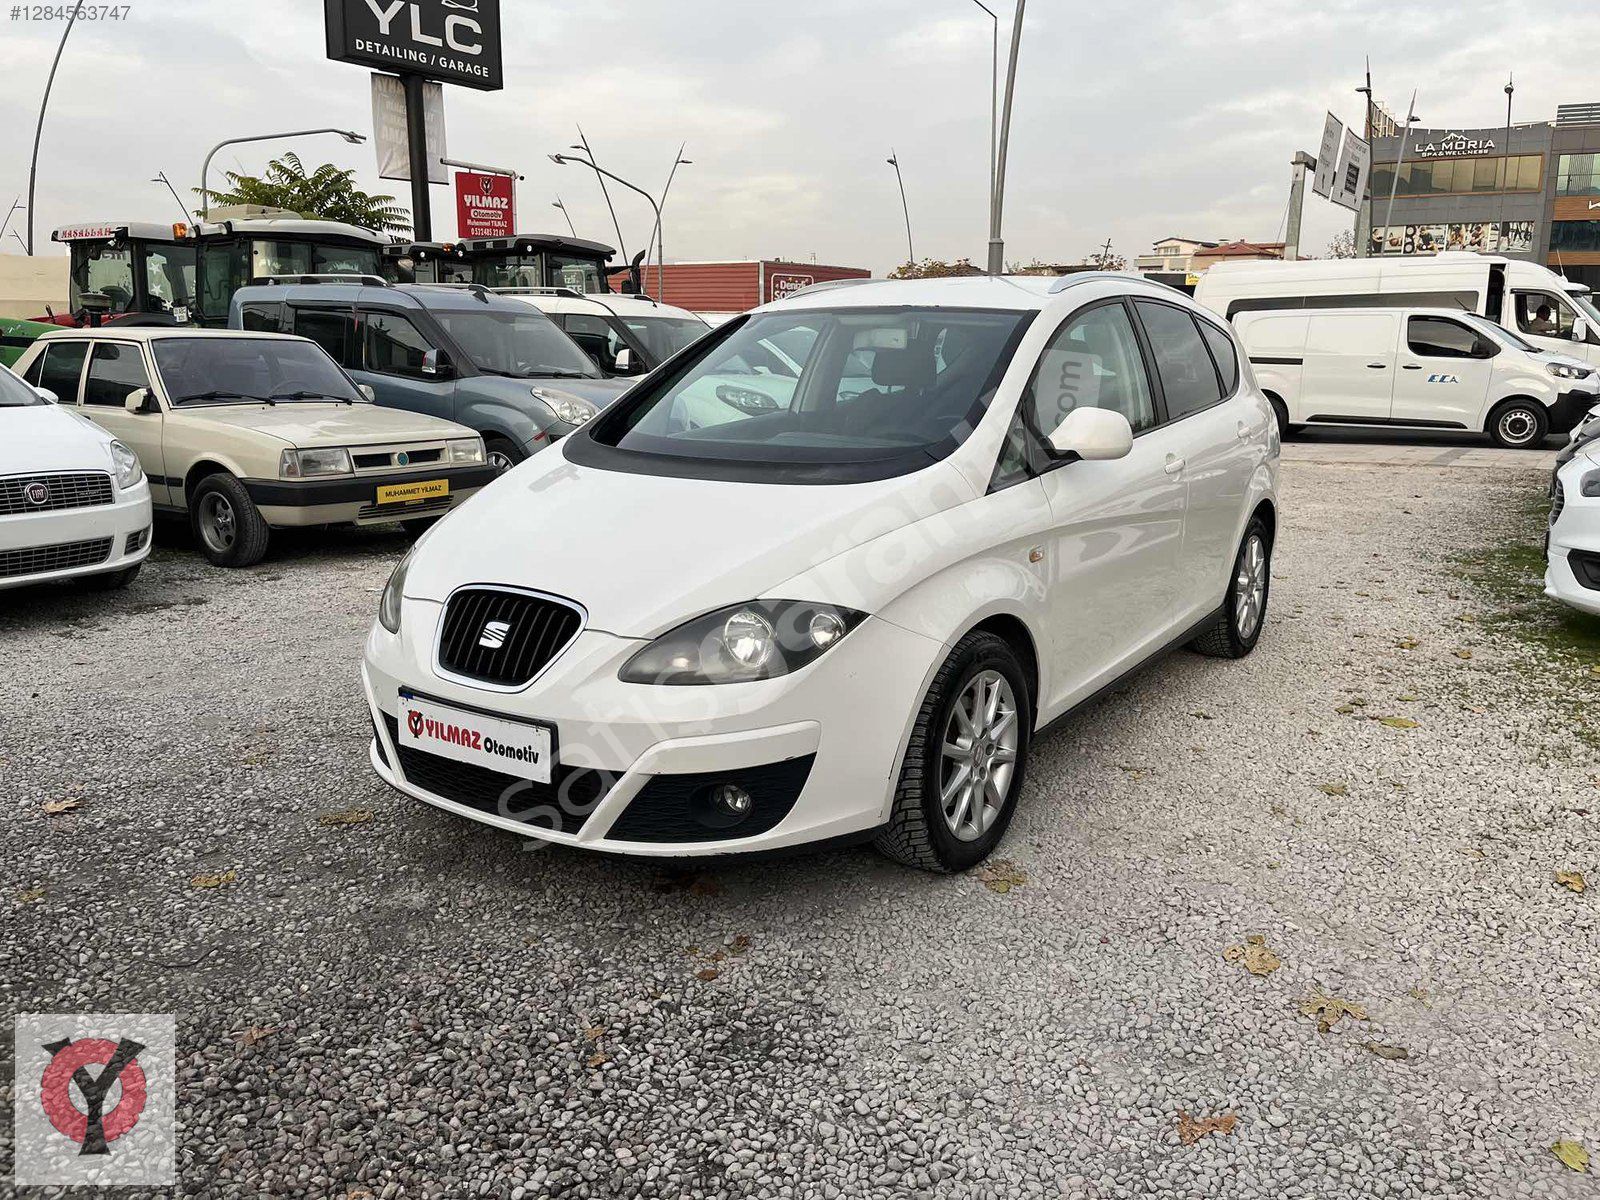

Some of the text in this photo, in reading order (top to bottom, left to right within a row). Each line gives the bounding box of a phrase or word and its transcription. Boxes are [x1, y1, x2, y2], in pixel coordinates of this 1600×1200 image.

[365, 0, 482, 55] YLC
[355, 39, 427, 64] DETAILING
[439, 56, 489, 78] GARAGE
[1415, 139, 1495, 152] LA MORIA
[463, 194, 508, 209] YILMAZ
[473, 210, 502, 219] Otomotiv
[1427, 374, 1459, 384] ECA
[31, 488, 45, 499] FIAT
[385, 487, 420, 498] MUHAMMET
[425, 718, 539, 765] YILMAZ Otomotiv
